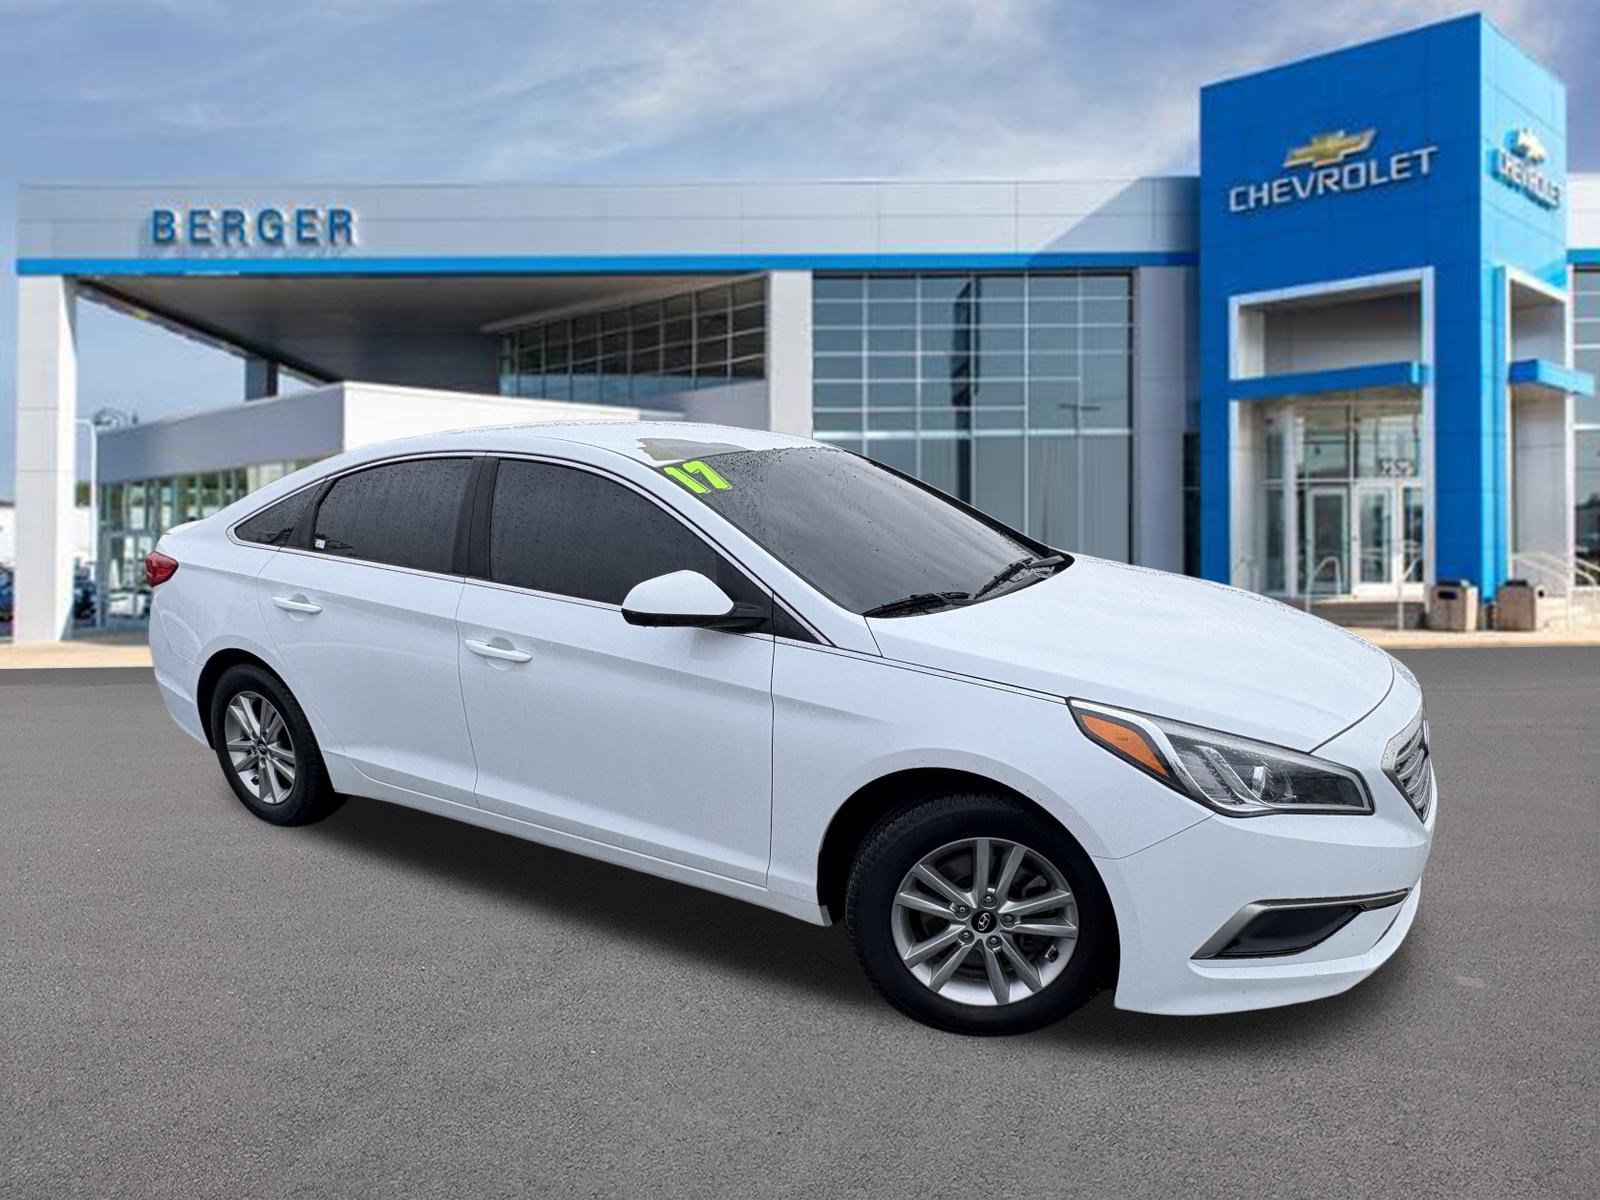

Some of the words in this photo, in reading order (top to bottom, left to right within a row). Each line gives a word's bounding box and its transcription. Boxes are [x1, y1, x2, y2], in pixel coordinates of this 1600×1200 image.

[1228, 146, 1437, 213] CHEVROLET
[152, 208, 355, 244] BERGER
[663, 460, 733, 494] 17
